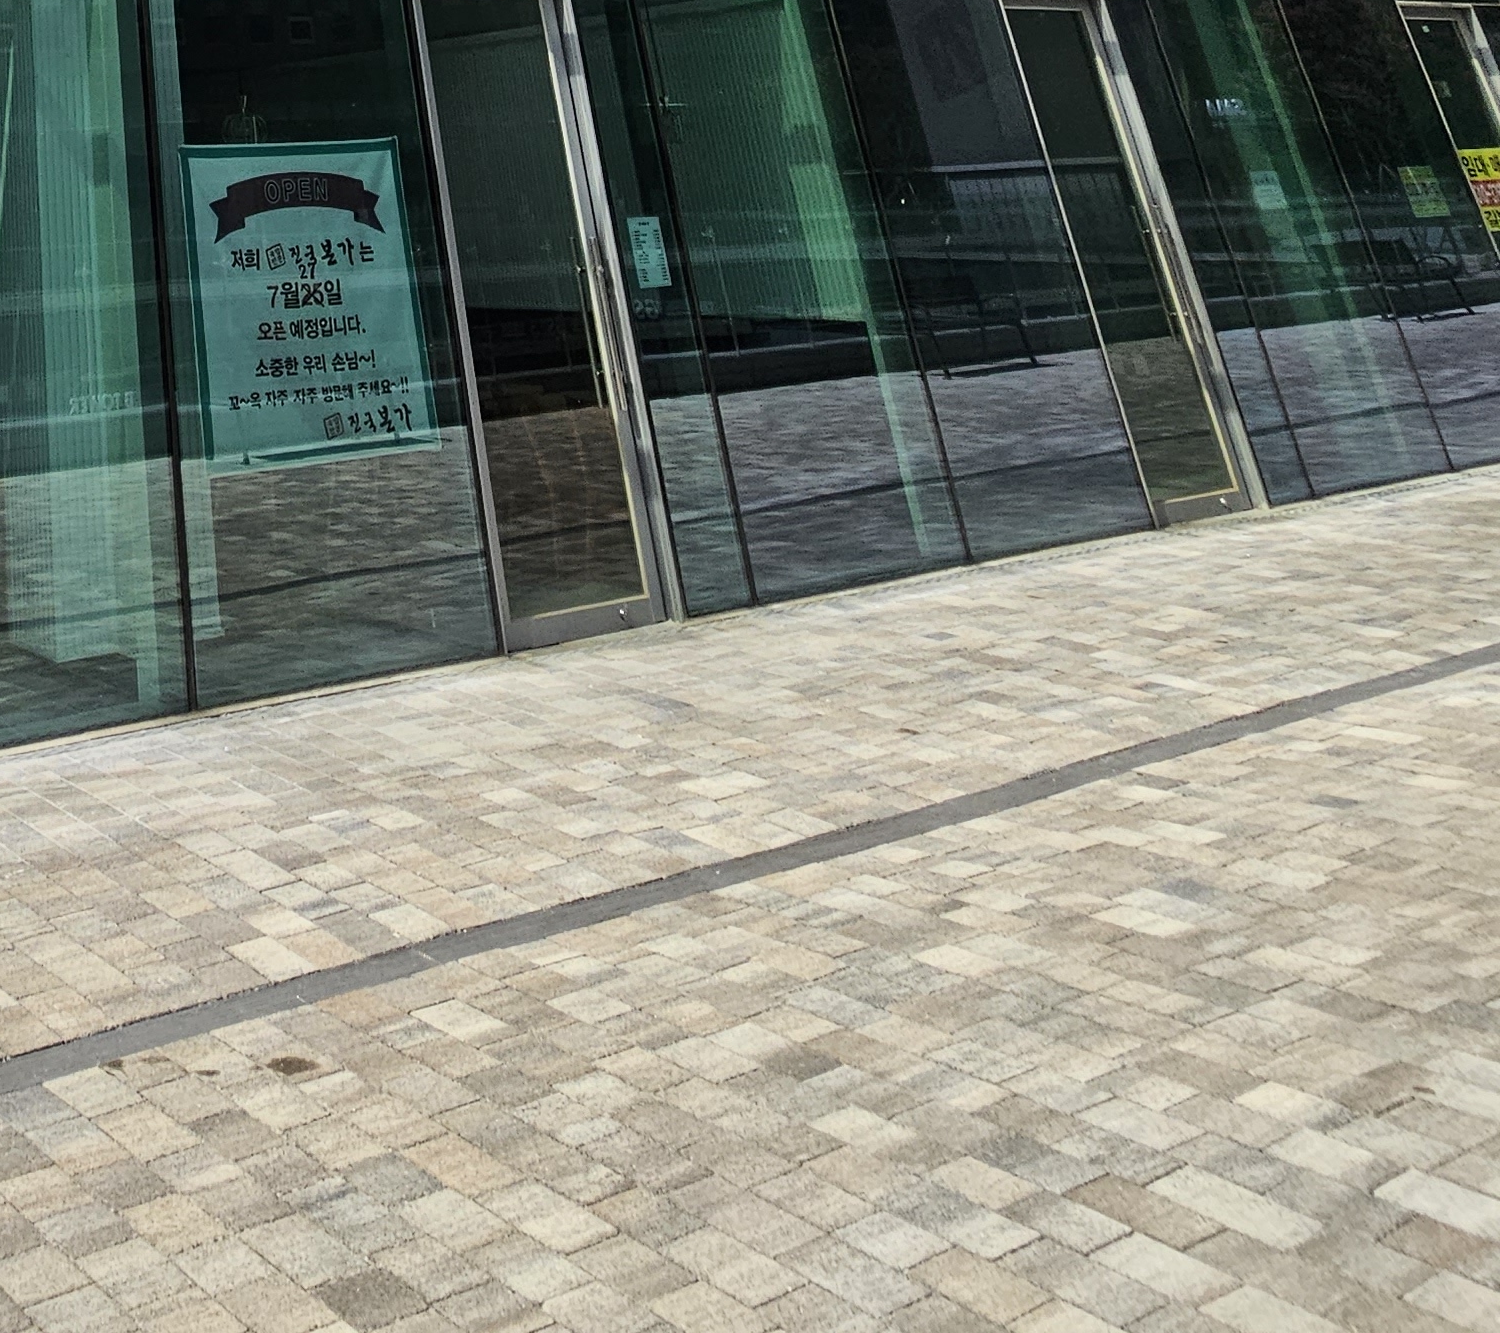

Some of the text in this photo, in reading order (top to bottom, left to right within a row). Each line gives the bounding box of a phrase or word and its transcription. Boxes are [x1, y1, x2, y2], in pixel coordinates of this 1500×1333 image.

[263, 177, 329, 205] OPEN
[230, 248, 261, 272] 저희
[298, 263, 316, 280] 27
[256, 314, 367, 342] 오픈 예정입니다.
[254, 358, 299, 378] 소중한
[302, 353, 327, 375] 우리
[264, 389, 289, 408] 자주
[292, 387, 318, 405] 자주
[347, 402, 413, 434] 진국본가
